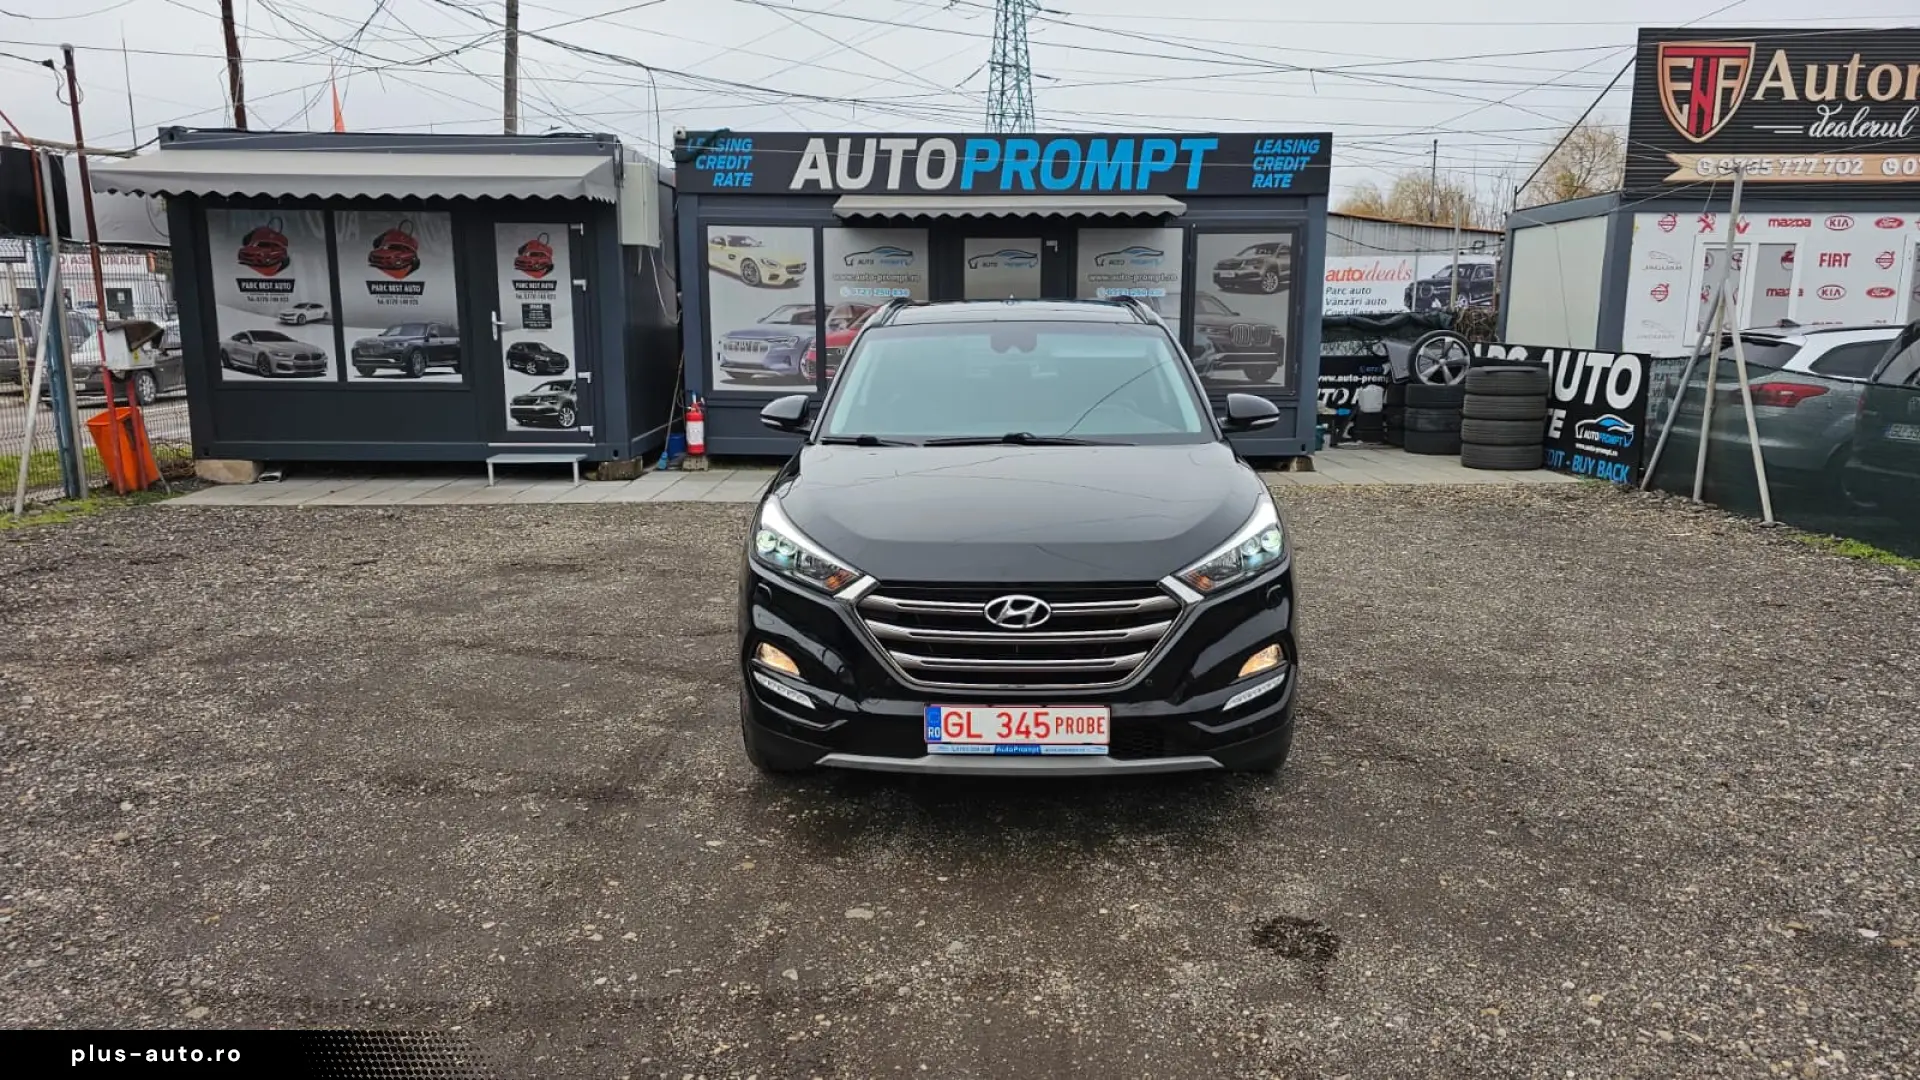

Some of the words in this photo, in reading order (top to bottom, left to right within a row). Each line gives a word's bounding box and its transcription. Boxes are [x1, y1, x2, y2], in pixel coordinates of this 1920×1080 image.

[1809, 104, 1920, 138] dealerul
[1253, 138, 1320, 155] LEASING
[695, 154, 753, 170] CREDIT
[789, 137, 1219, 191] AUTOPROMPT
[1252, 156, 1311, 172] CREDIT
[1779, 157, 1818, 176] 777
[1823, 157, 1863, 176] 702
[712, 172, 753, 187] RATE
[1252, 173, 1292, 188] RATE
[1829, 218, 1849, 228] KIA
[1877, 217, 1899, 228] Ford
[1818, 252, 1852, 268] FIAT
[1325, 258, 1413, 282] autoideals
[1325, 286, 1346, 295] Parc
[1350, 286, 1372, 295] auto
[1766, 287, 1804, 298] maza
[1821, 288, 1842, 297] KIA
[1869, 287, 1891, 298] Ford
[1364, 298, 1388, 306] auto
[1571, 454, 1597, 475] BUY
[1596, 459, 1631, 484] BACK
[927, 726, 941, 738] RO
[943, 711, 983, 739] GL
[996, 711, 1051, 739] 345
[1055, 716, 1105, 735] PROBE
